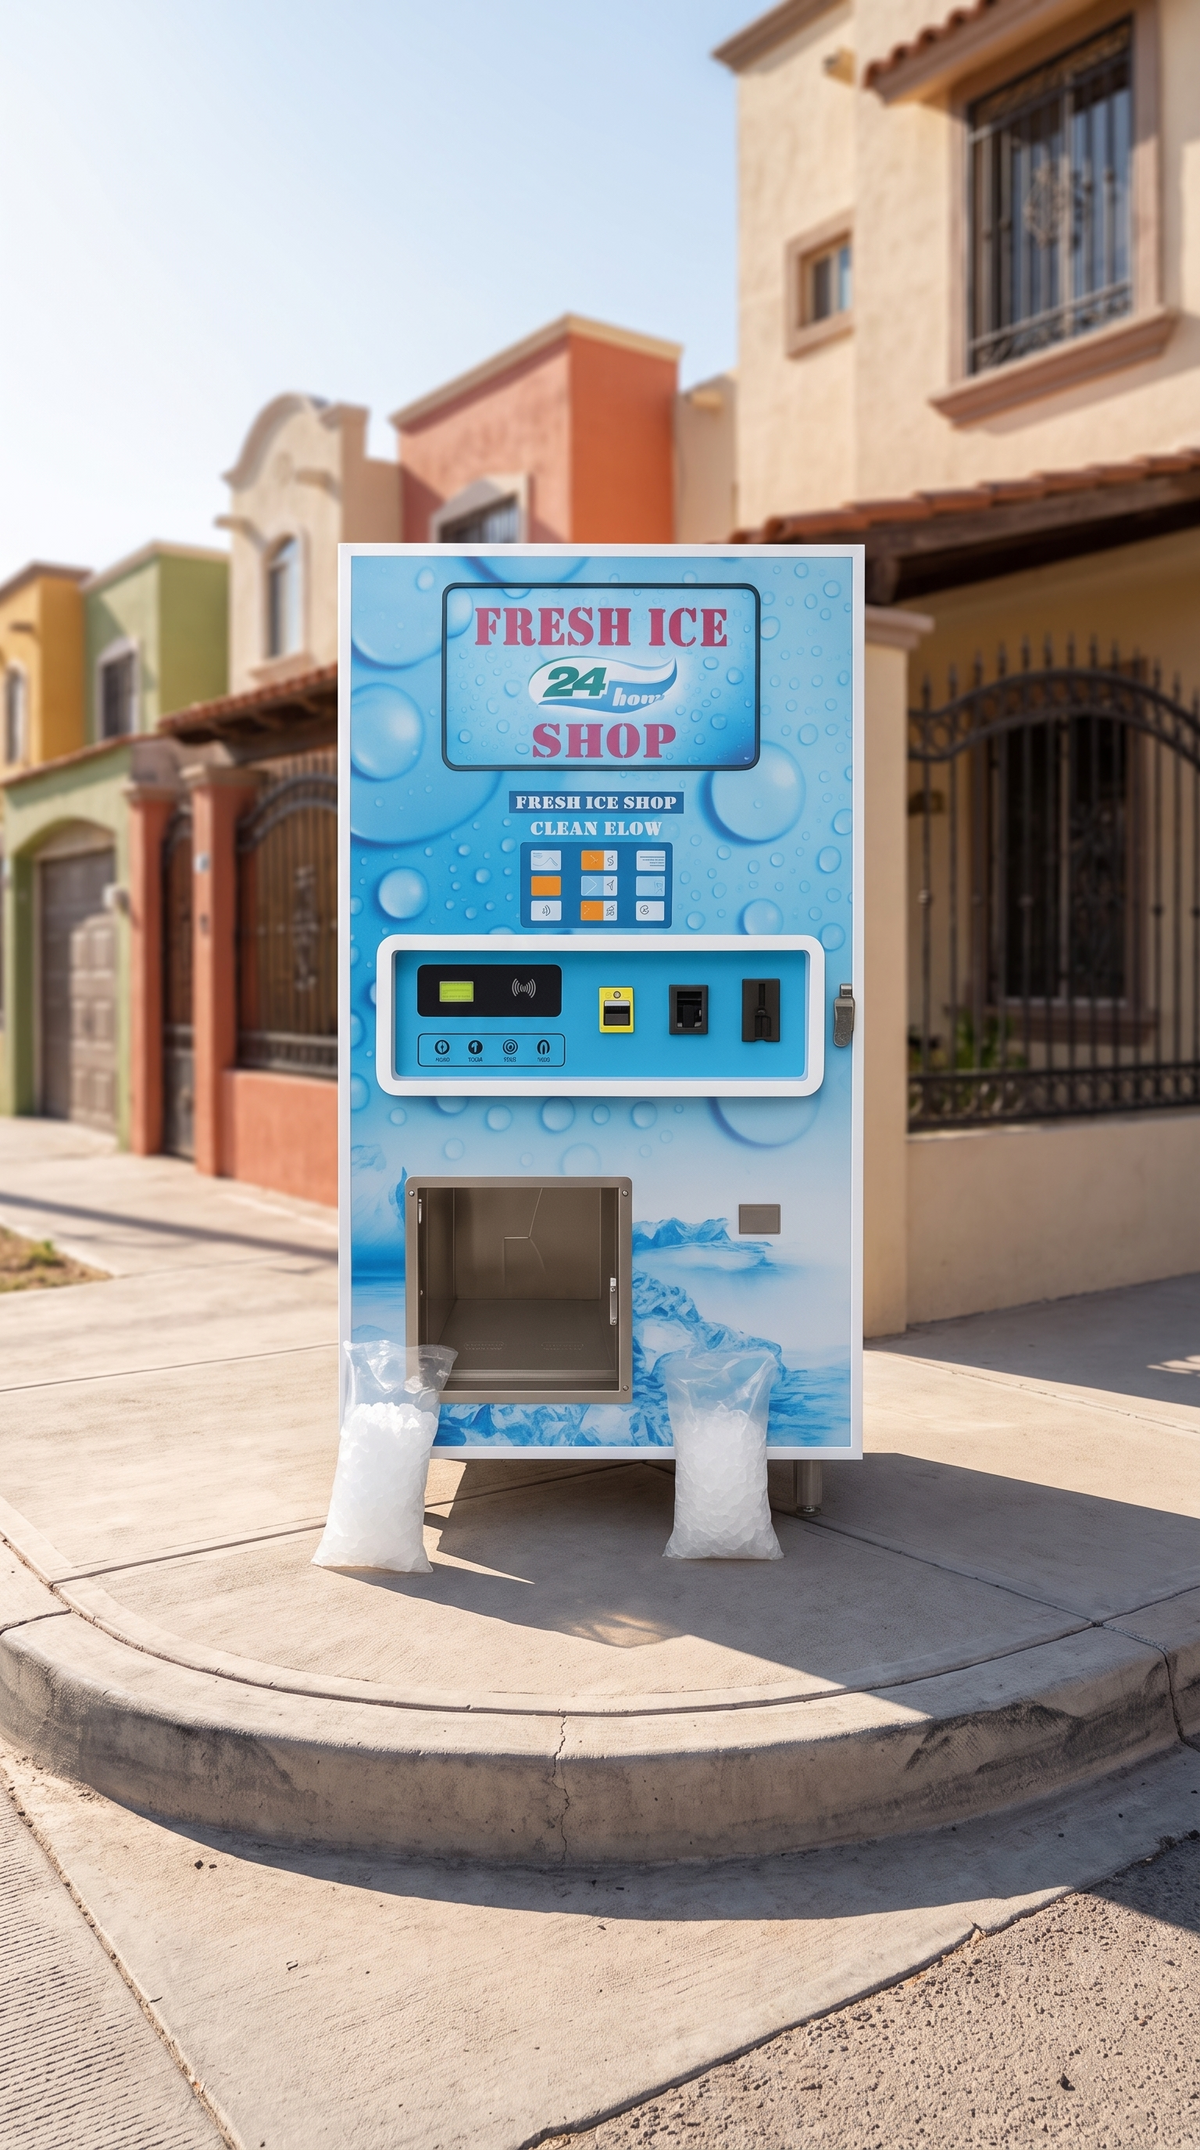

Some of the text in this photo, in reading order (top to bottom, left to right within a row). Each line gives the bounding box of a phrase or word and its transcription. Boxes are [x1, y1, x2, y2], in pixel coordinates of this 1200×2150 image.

[474, 607, 728, 647] FRESH ICE
[542, 666, 607, 698] 24
[532, 723, 677, 759] SHOP
[515, 795, 677, 810] FRESH ICE SHOP
[530, 821, 663, 836] CLEAN ELOW
